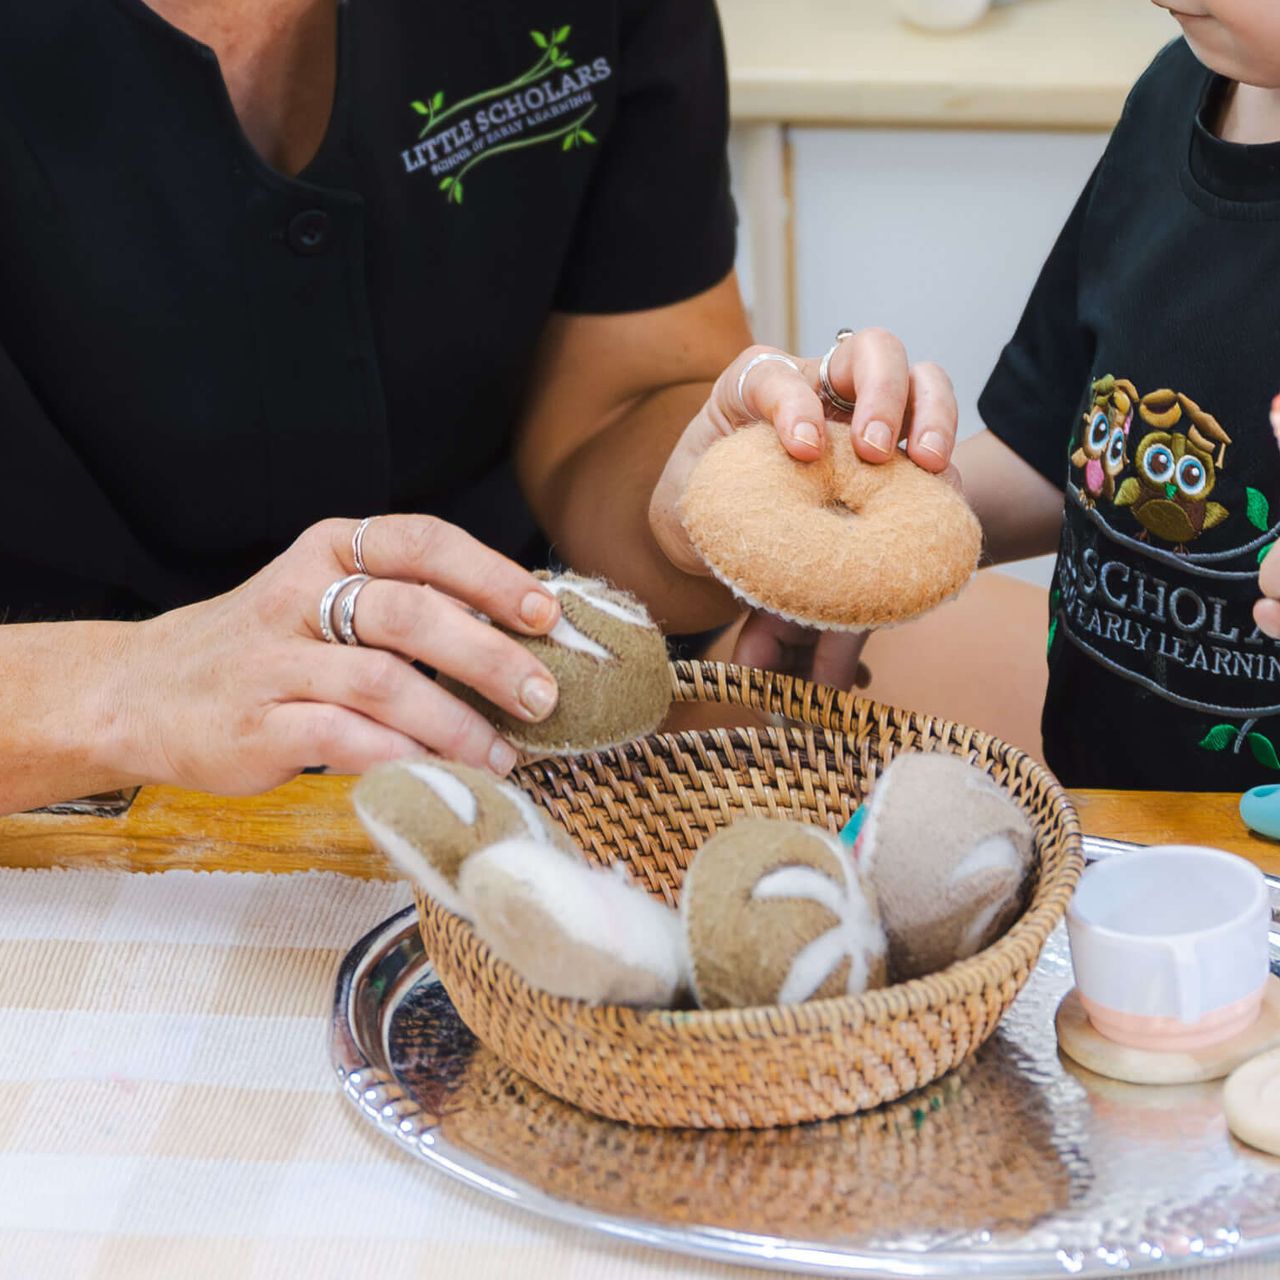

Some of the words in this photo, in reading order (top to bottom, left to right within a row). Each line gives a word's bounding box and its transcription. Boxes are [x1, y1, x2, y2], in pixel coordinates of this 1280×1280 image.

[401, 119, 475, 172] LITTLE
[475, 56, 612, 133] SCHOLARS
[486, 120, 523, 145] EARLY
[525, 90, 593, 127] LEARNING
